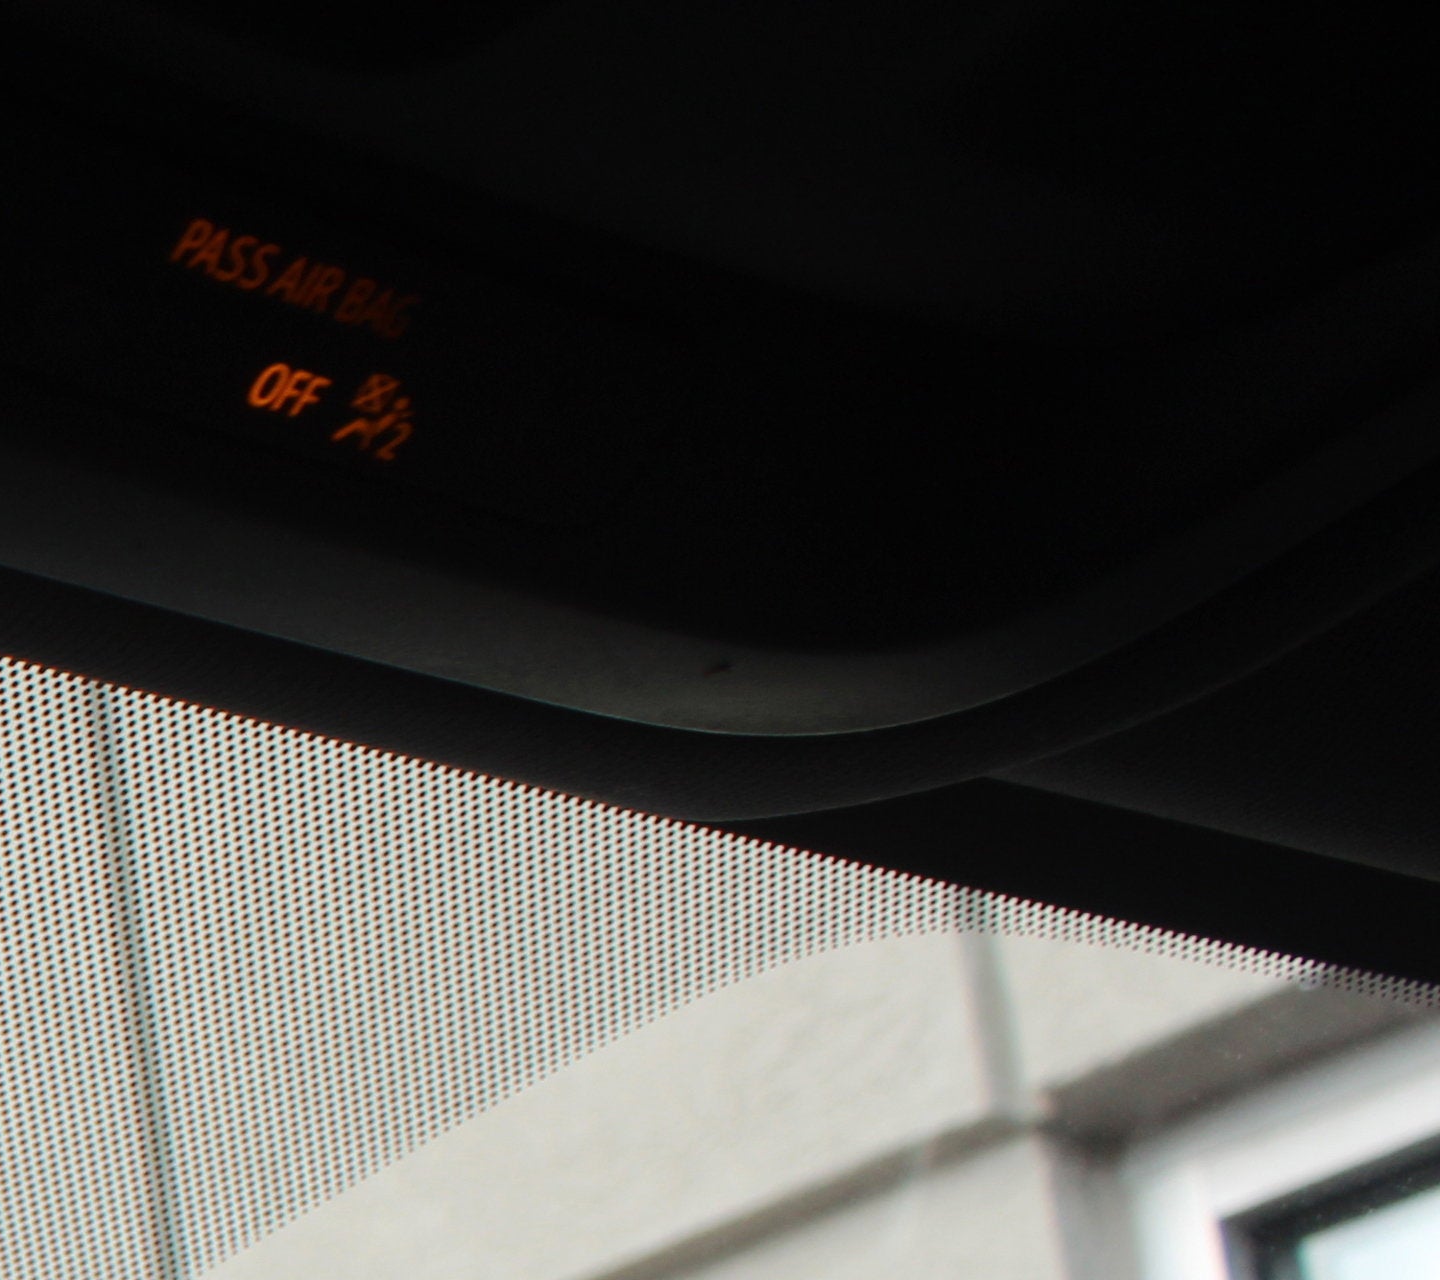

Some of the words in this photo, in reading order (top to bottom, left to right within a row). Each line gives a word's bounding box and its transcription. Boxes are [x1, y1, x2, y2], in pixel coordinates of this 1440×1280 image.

[169, 218, 280, 291] PASS
[265, 256, 347, 314] AIR
[246, 362, 333, 417] OFF
